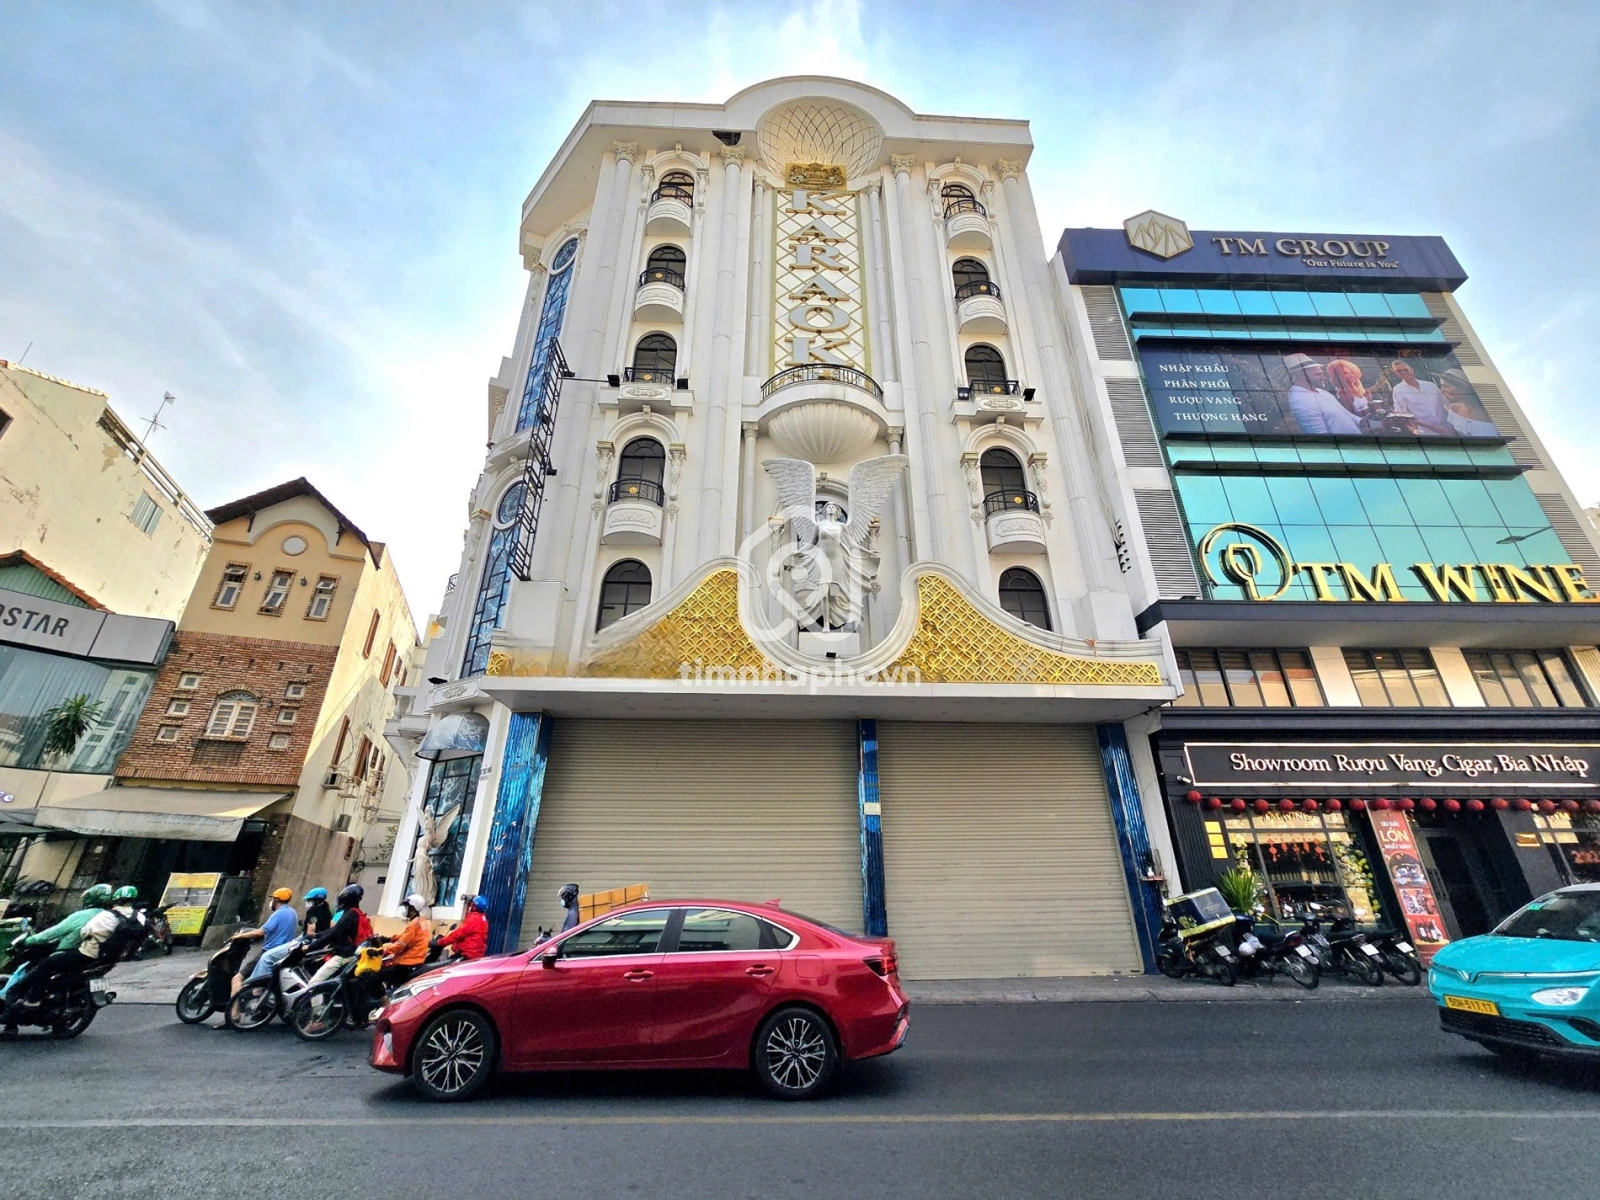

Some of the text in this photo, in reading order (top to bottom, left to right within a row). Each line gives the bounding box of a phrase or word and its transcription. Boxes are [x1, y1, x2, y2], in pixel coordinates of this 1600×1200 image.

[1212, 237, 1391, 257] TM GROUP
[1159, 363, 1192, 373] NHẬP
[1164, 379, 1198, 388] PHÂN
[1169, 396, 1242, 405] RƯỢU VANG
[1174, 412, 1268, 422] THƯỢNG HẠNG
[1293, 562, 1600, 602] TM WINE
[1230, 752, 1332, 772] Showroom
[1333, 754, 1388, 775] Rượu
[1389, 754, 1442, 777] Vang,
[1442, 754, 1498, 777] Cigar,
[1496, 754, 1531, 772] Bia
[1379, 827, 1410, 842] LỚN
